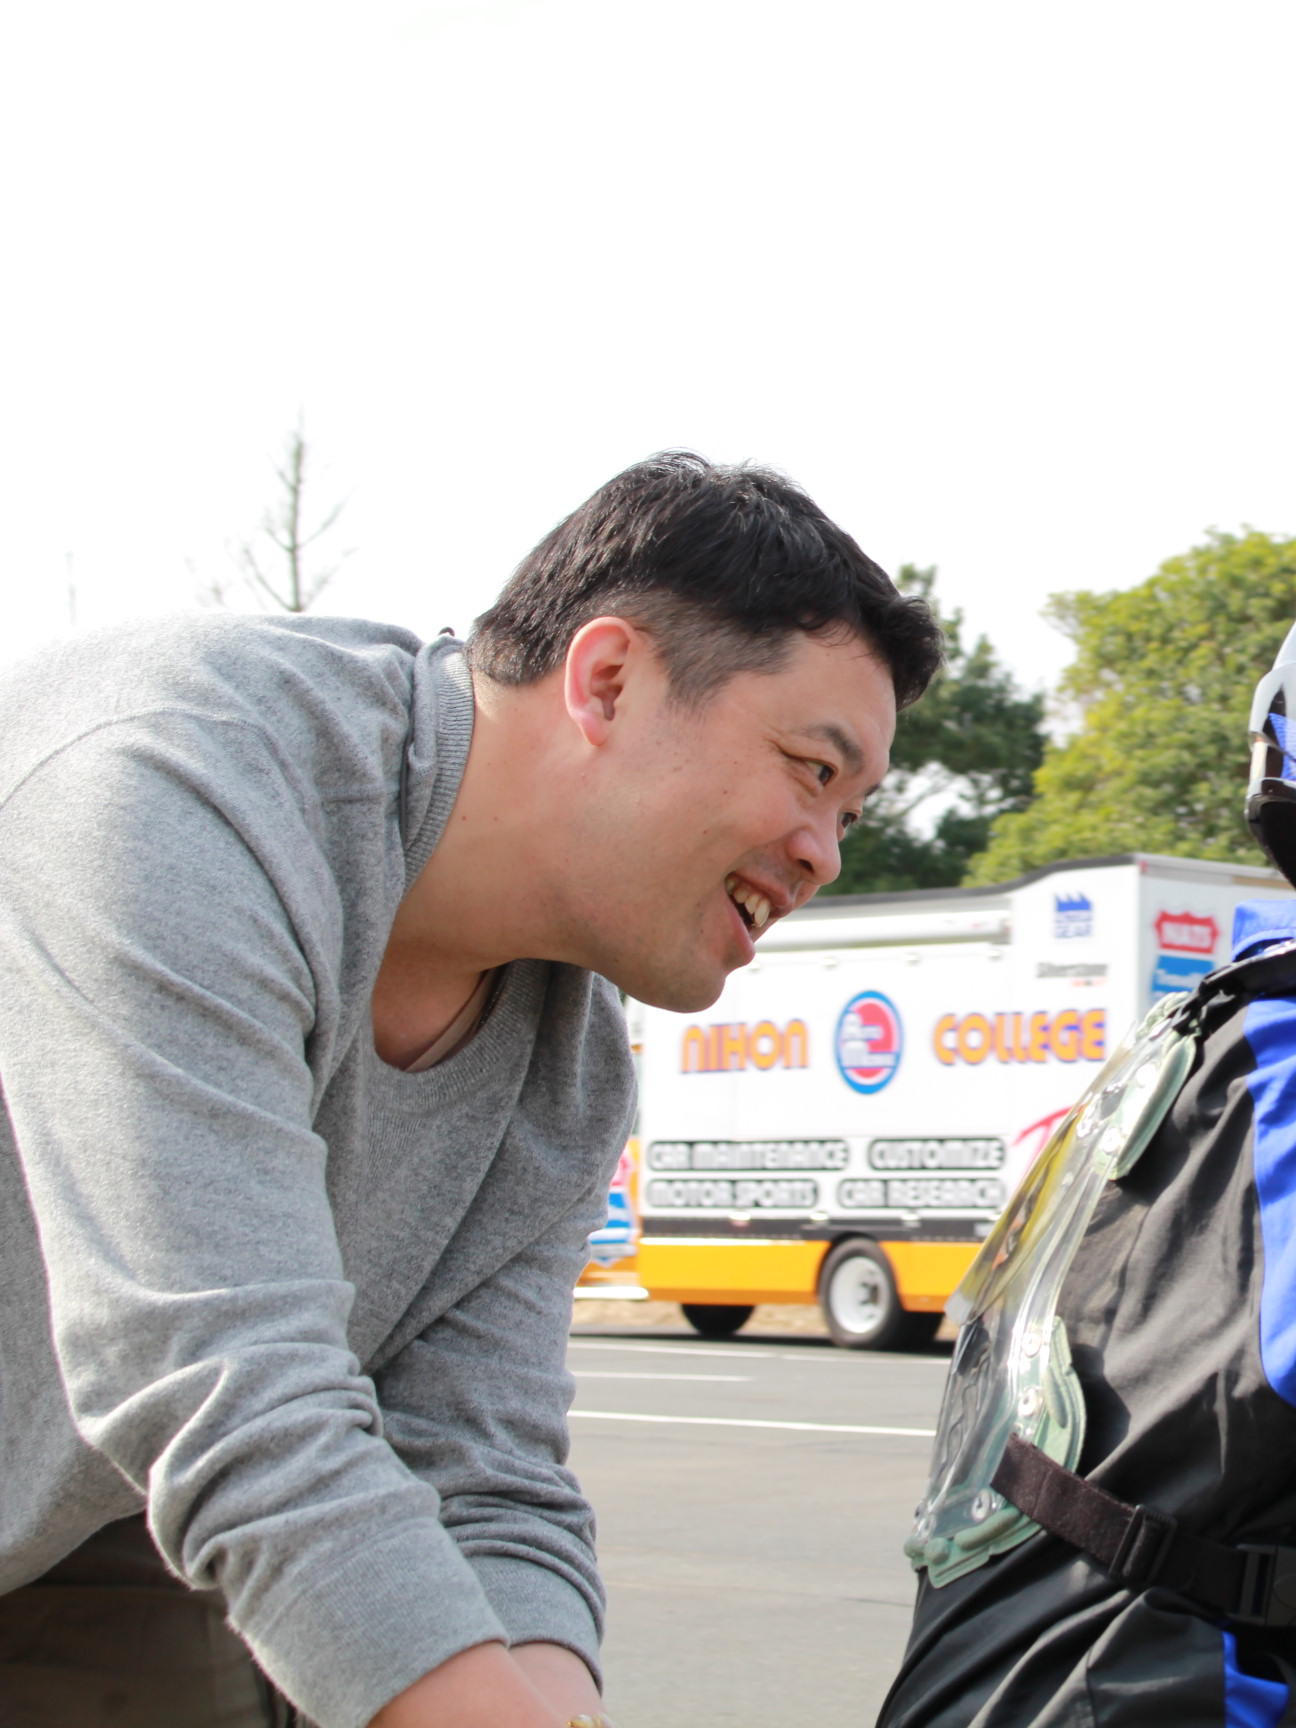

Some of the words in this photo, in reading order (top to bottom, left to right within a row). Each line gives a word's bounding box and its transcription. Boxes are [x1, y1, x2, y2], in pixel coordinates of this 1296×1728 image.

[680, 1018, 809, 1074] NIHON
[932, 1008, 1106, 1067] COLLEGE
[652, 1143, 689, 1169] CAR
[692, 1141, 847, 1169] MAINTENANCE
[870, 1139, 1003, 1168] CUSTOMIZE
[843, 1179, 884, 1207] CAR
